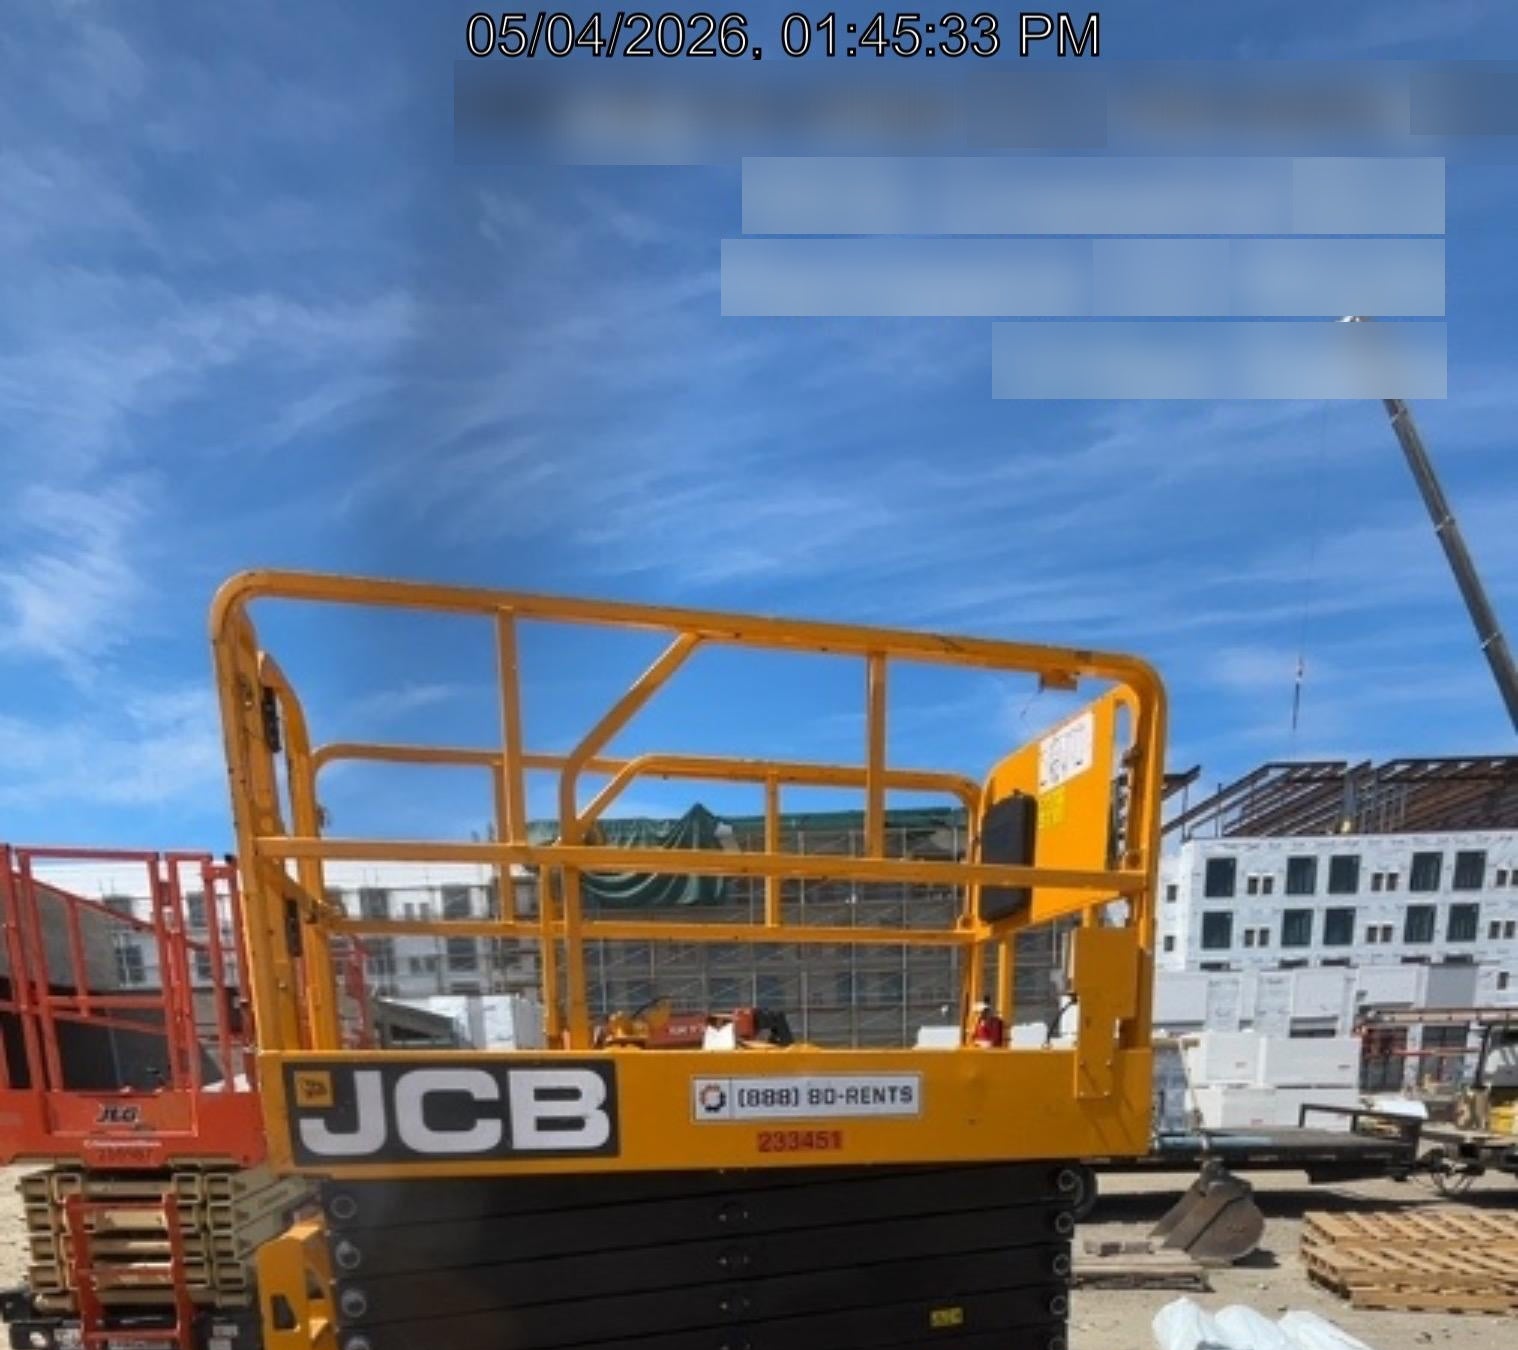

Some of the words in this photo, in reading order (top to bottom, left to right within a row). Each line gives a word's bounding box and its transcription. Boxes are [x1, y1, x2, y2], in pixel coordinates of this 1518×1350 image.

[738, 1087, 799, 1108] (888)
[299, 1067, 611, 1156] JCB
[757, 1130, 844, 1153] 233451
